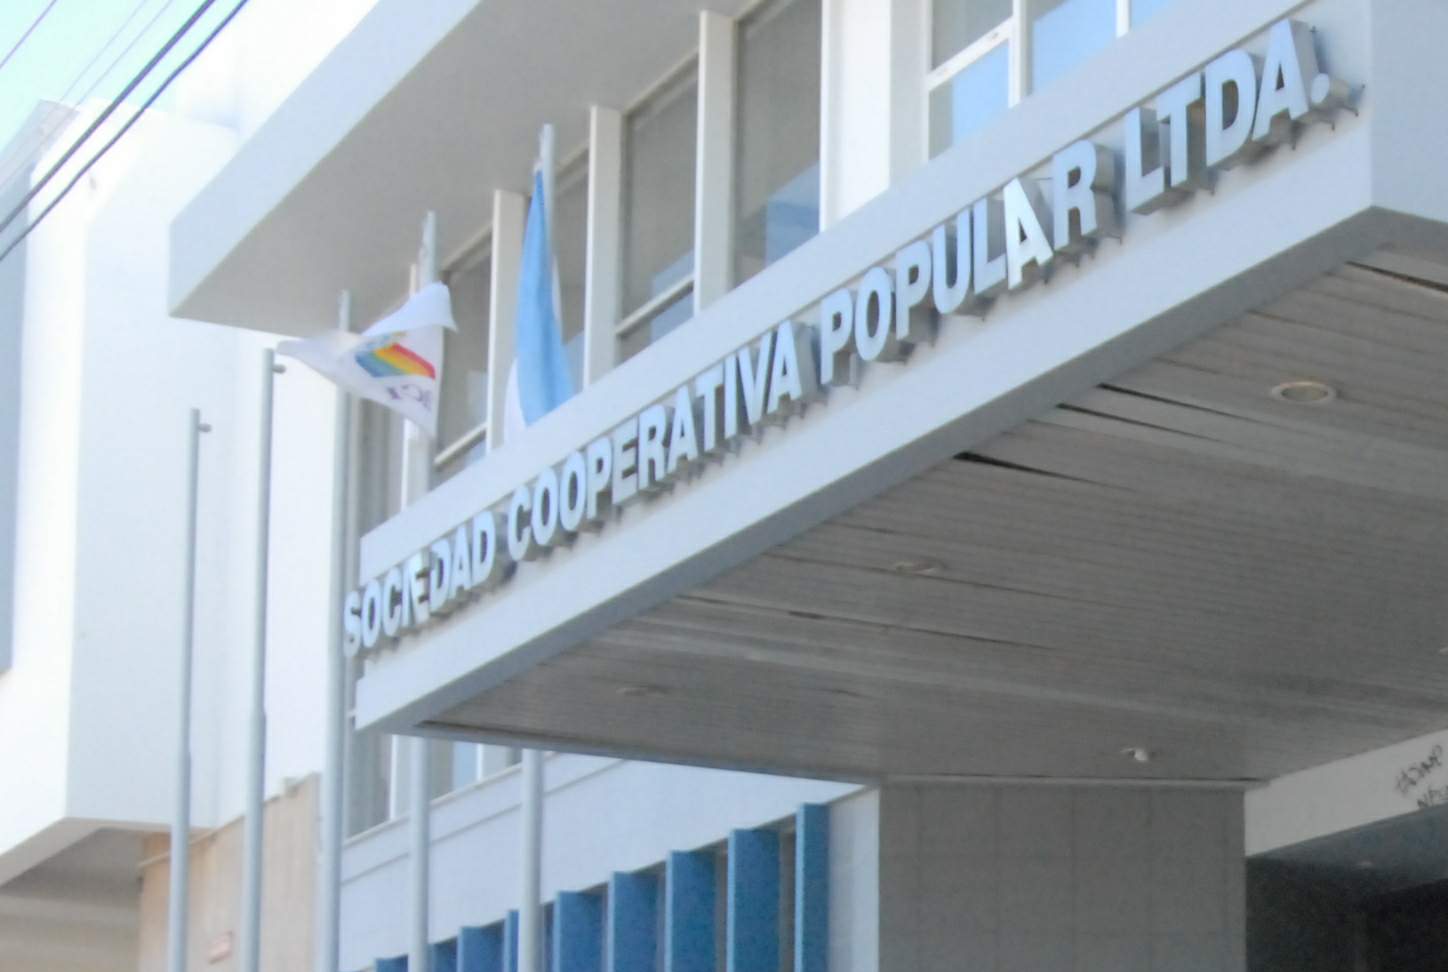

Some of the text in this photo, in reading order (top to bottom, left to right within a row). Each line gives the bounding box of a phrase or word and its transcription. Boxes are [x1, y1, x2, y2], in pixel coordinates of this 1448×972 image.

[344, 18, 1331, 657] SOCIEDAD COOPERATIVA POPULAR LTDA.
